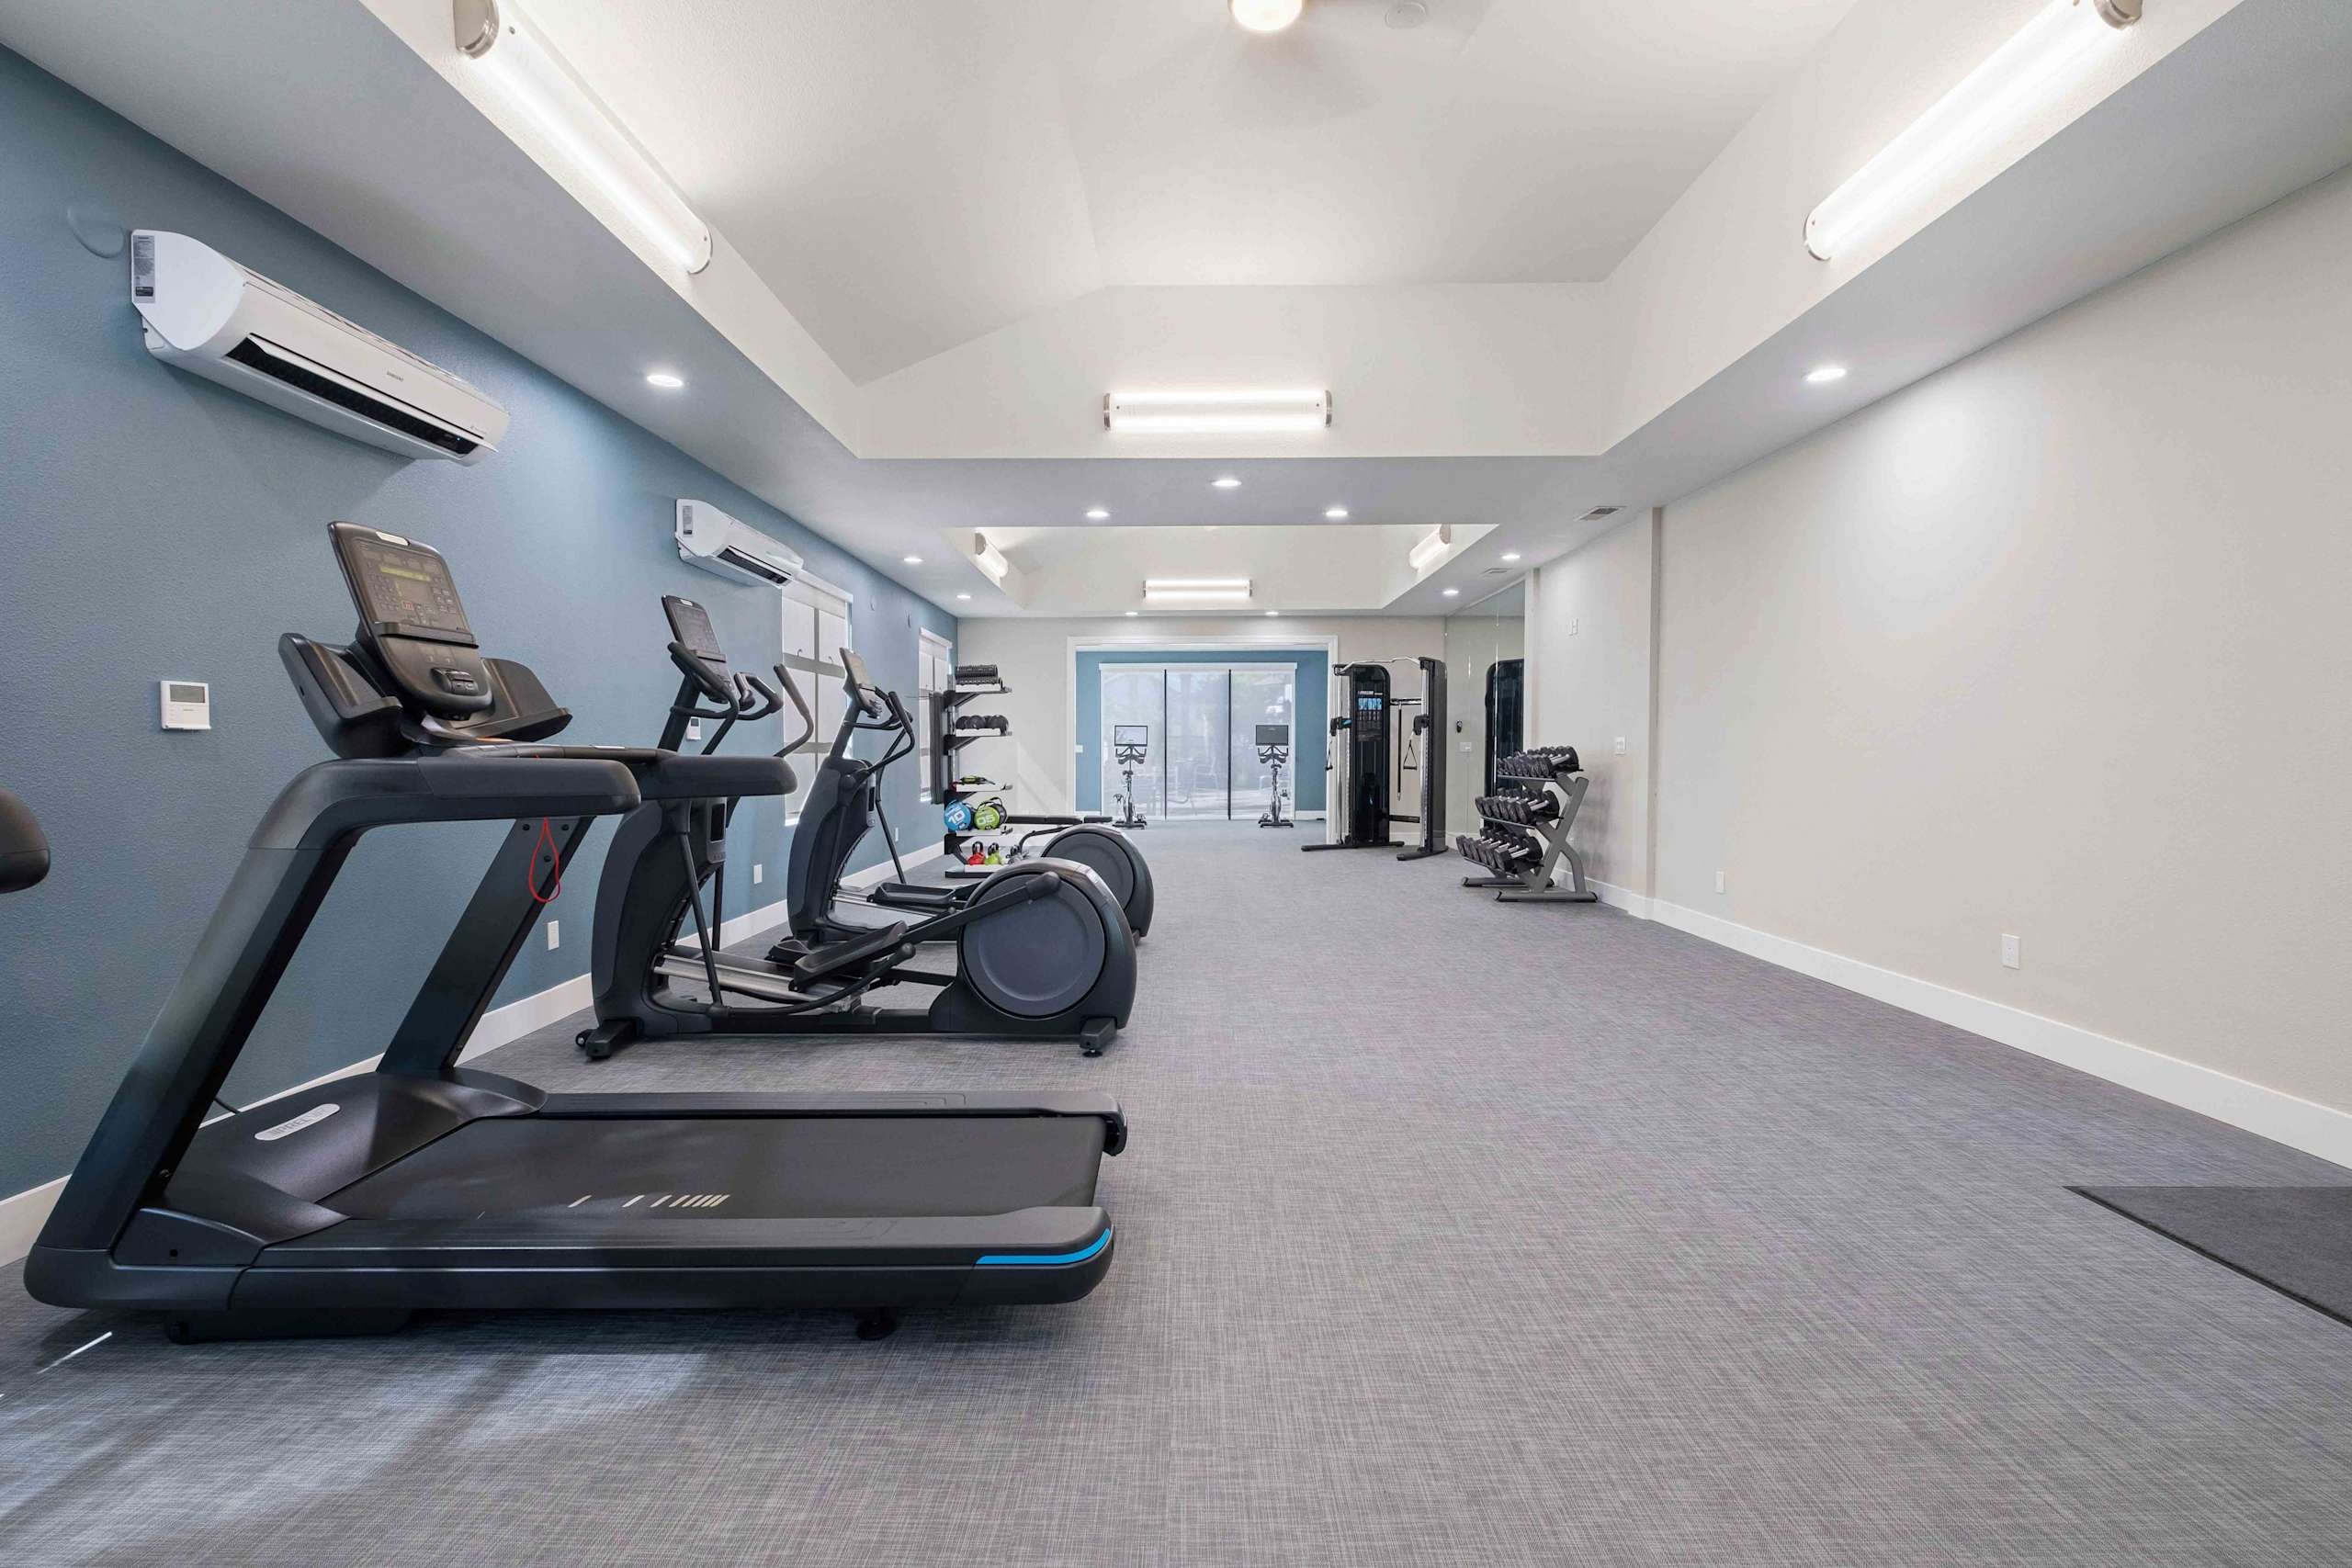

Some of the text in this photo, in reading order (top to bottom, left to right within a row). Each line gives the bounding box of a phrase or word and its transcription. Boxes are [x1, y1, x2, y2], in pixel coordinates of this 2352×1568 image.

[947, 809, 965, 825] 10
[976, 815, 995, 825] 05
[276, 1107, 324, 1134] PREC
